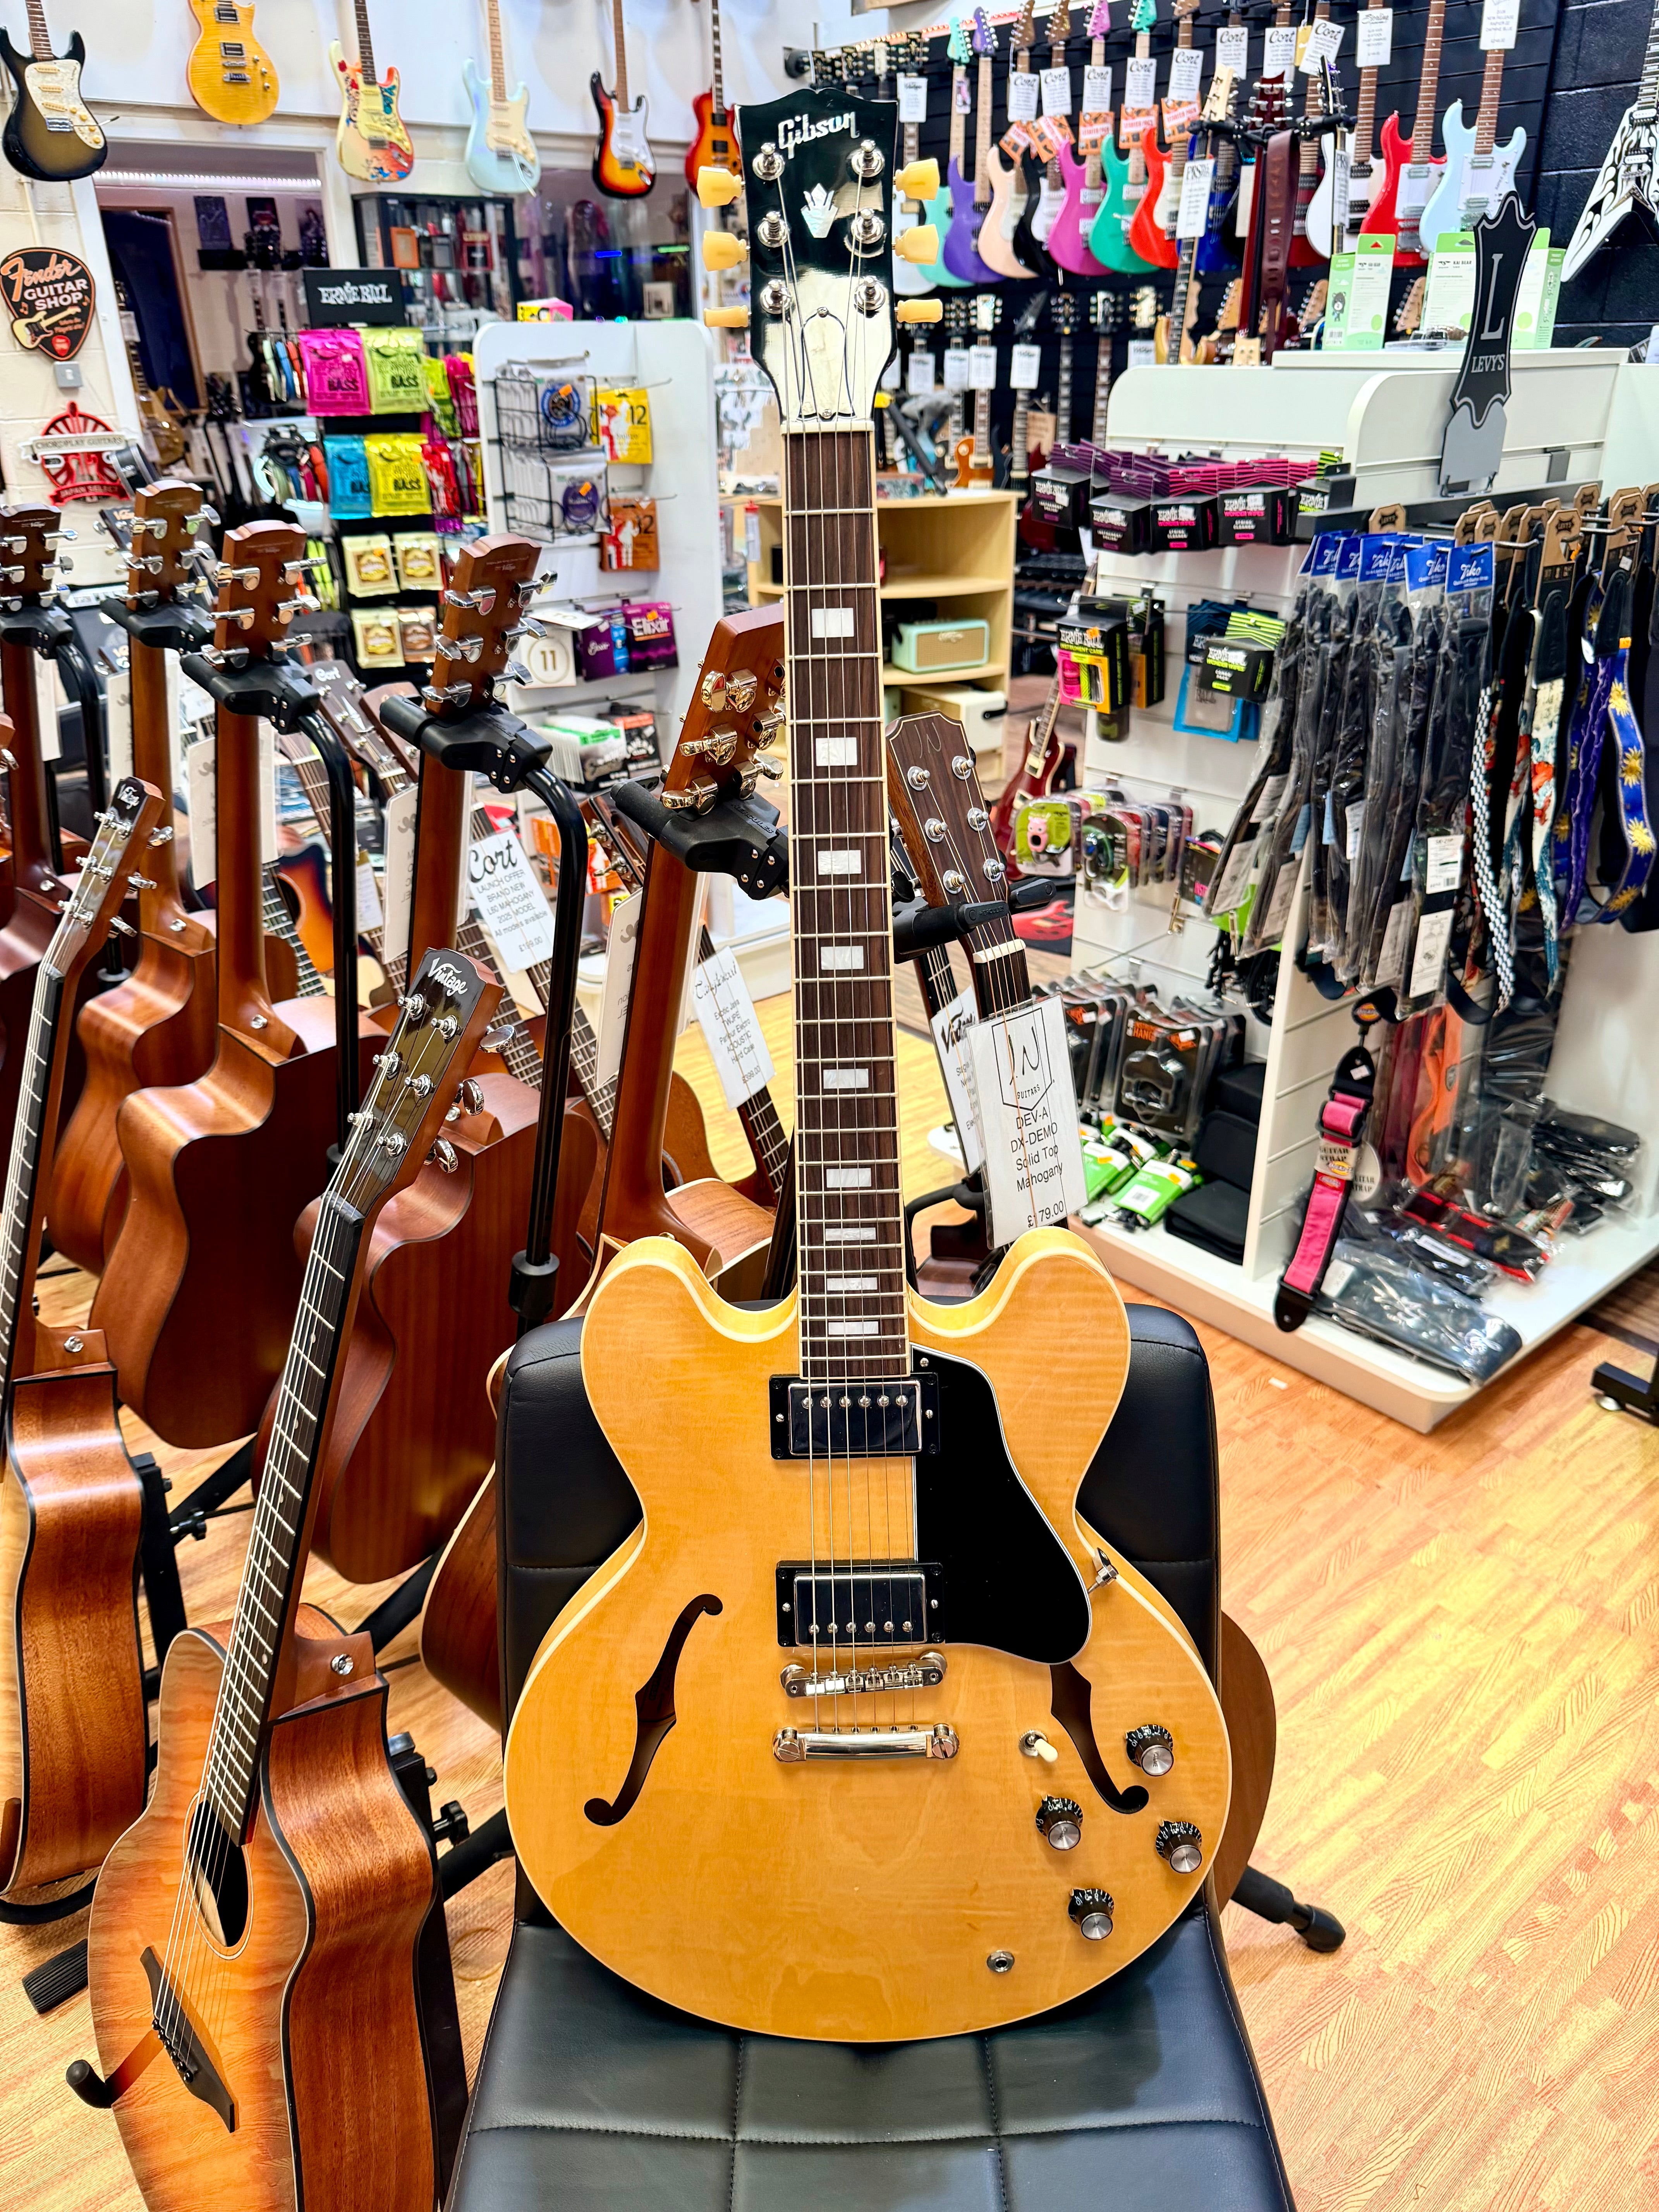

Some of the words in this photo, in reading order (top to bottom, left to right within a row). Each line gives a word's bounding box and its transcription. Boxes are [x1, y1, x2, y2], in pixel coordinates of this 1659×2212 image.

[1220, 31, 1245, 44] Cort
[1269, 30, 1295, 44] Cort
[1315, 23, 1341, 40] Cort
[1130, 60, 1153, 73] Cort
[1175, 51, 1200, 65] Cort
[1013, 75, 1037, 87] Cort
[1044, 71, 1067, 84] Cort
[1087, 69, 1109, 81] Cort
[778, 111, 860, 160] Gibson
[0, 254, 82, 302] Fender
[24, 279, 89, 300] GUITAR
[317, 281, 359, 305] ERNIE
[360, 283, 393, 304] BALL
[34, 292, 83, 311] SHOP
[1471, 354, 1506, 374] LEVY'S
[629, 404, 648, 425] 12
[1300, 492, 1324, 509] ERNIE
[1426, 557, 1446, 576] Tiko
[1460, 560, 1482, 580] Tiko
[631, 617, 670, 637] Elixir
[1060, 628, 1083, 646] ERNIE
[1060, 642, 1089, 653] INSTRUMENT
[540, 650, 556, 672] 11
[314, 667, 341, 682] Cort
[117, 783, 140, 809] Vintage
[470, 839, 517, 883] Cort
[476, 878, 505, 894] LAUNCH
[504, 869, 526, 884] OFFER
[486, 888, 510, 903] BRAND
[510, 881, 526, 893] NEW
[500, 890, 535, 909] MAHOGANY
[497, 912, 512, 924] 2025
[514, 902, 536, 916] MODEL
[495, 929, 503, 938] All
[503, 922, 524, 934] models
[525, 910, 548, 925] available
[428, 957, 468, 996] Vintage
[730, 998, 740, 1012] Java
[736, 1018, 751, 1034] Electro
[726, 1033, 752, 1054] ACOUSTIC
[743, 1043, 756, 1056] Case
[1017, 1084, 1041, 1099] GUITARS
[1016, 1106, 1049, 1130] DEV-A
[1010, 1122, 1058, 1153] DX-DEMO
[1016, 1150, 1040, 1171] Solid
[1042, 1144, 1059, 1160] Top
[1017, 1162, 1063, 1192] Mahogany
[1355, 1175, 1375, 1183] UITAR
